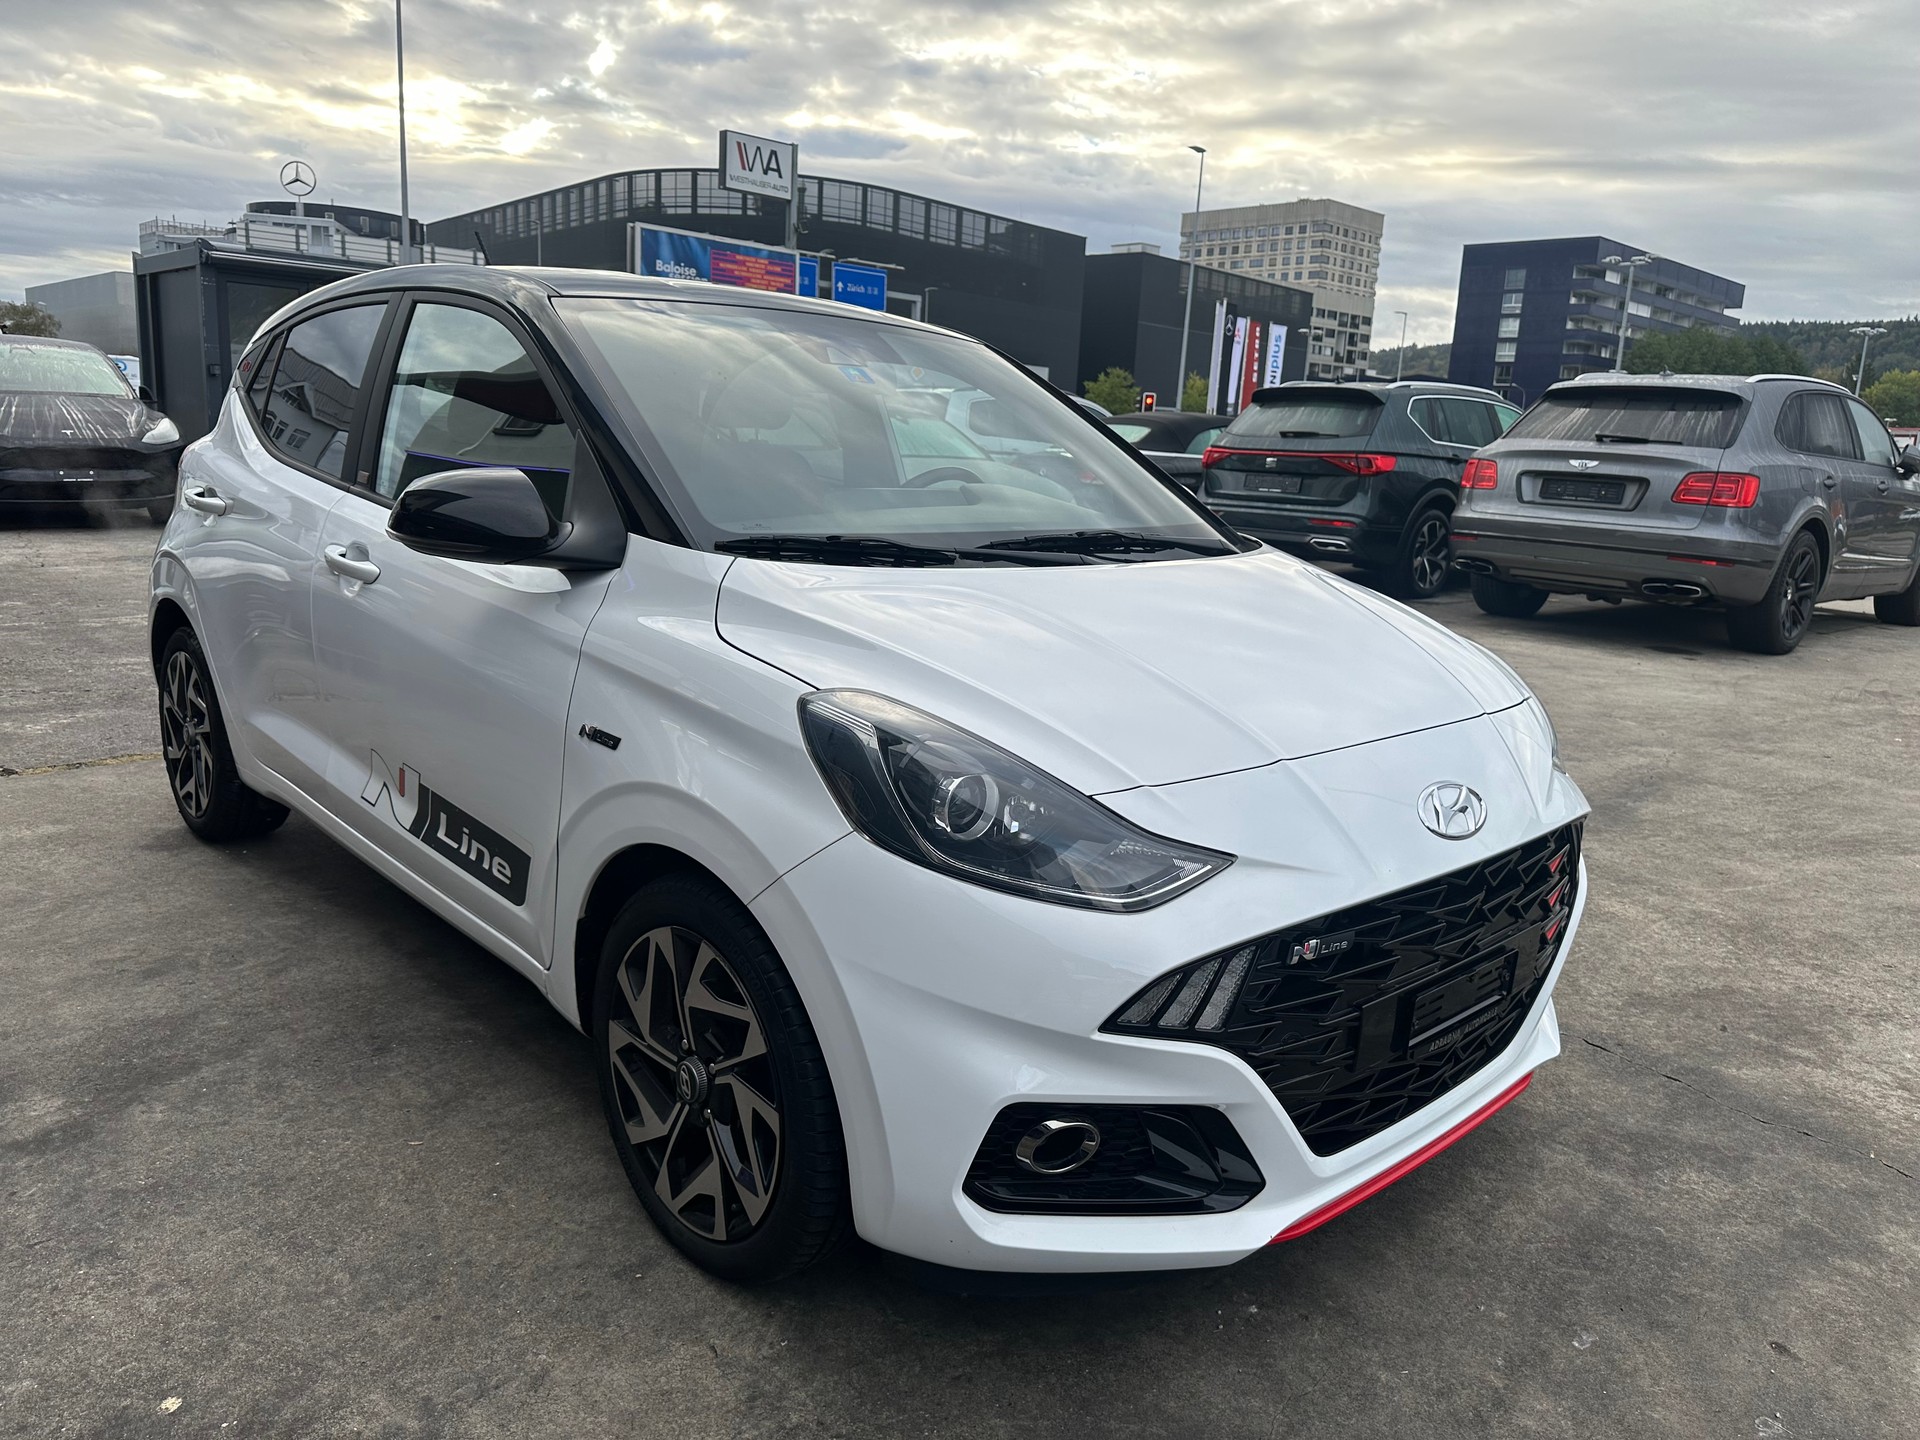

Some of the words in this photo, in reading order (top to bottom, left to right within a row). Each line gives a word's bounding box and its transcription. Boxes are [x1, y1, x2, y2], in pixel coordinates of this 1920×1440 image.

[655, 259, 697, 276] Baloise
[846, 282, 865, 293] Zürich
[1270, 334, 1281, 387] NIplus
[436, 811, 513, 885] Line
[1320, 940, 1348, 954] Line
[1428, 1029, 1461, 1052] ADRAGNA
